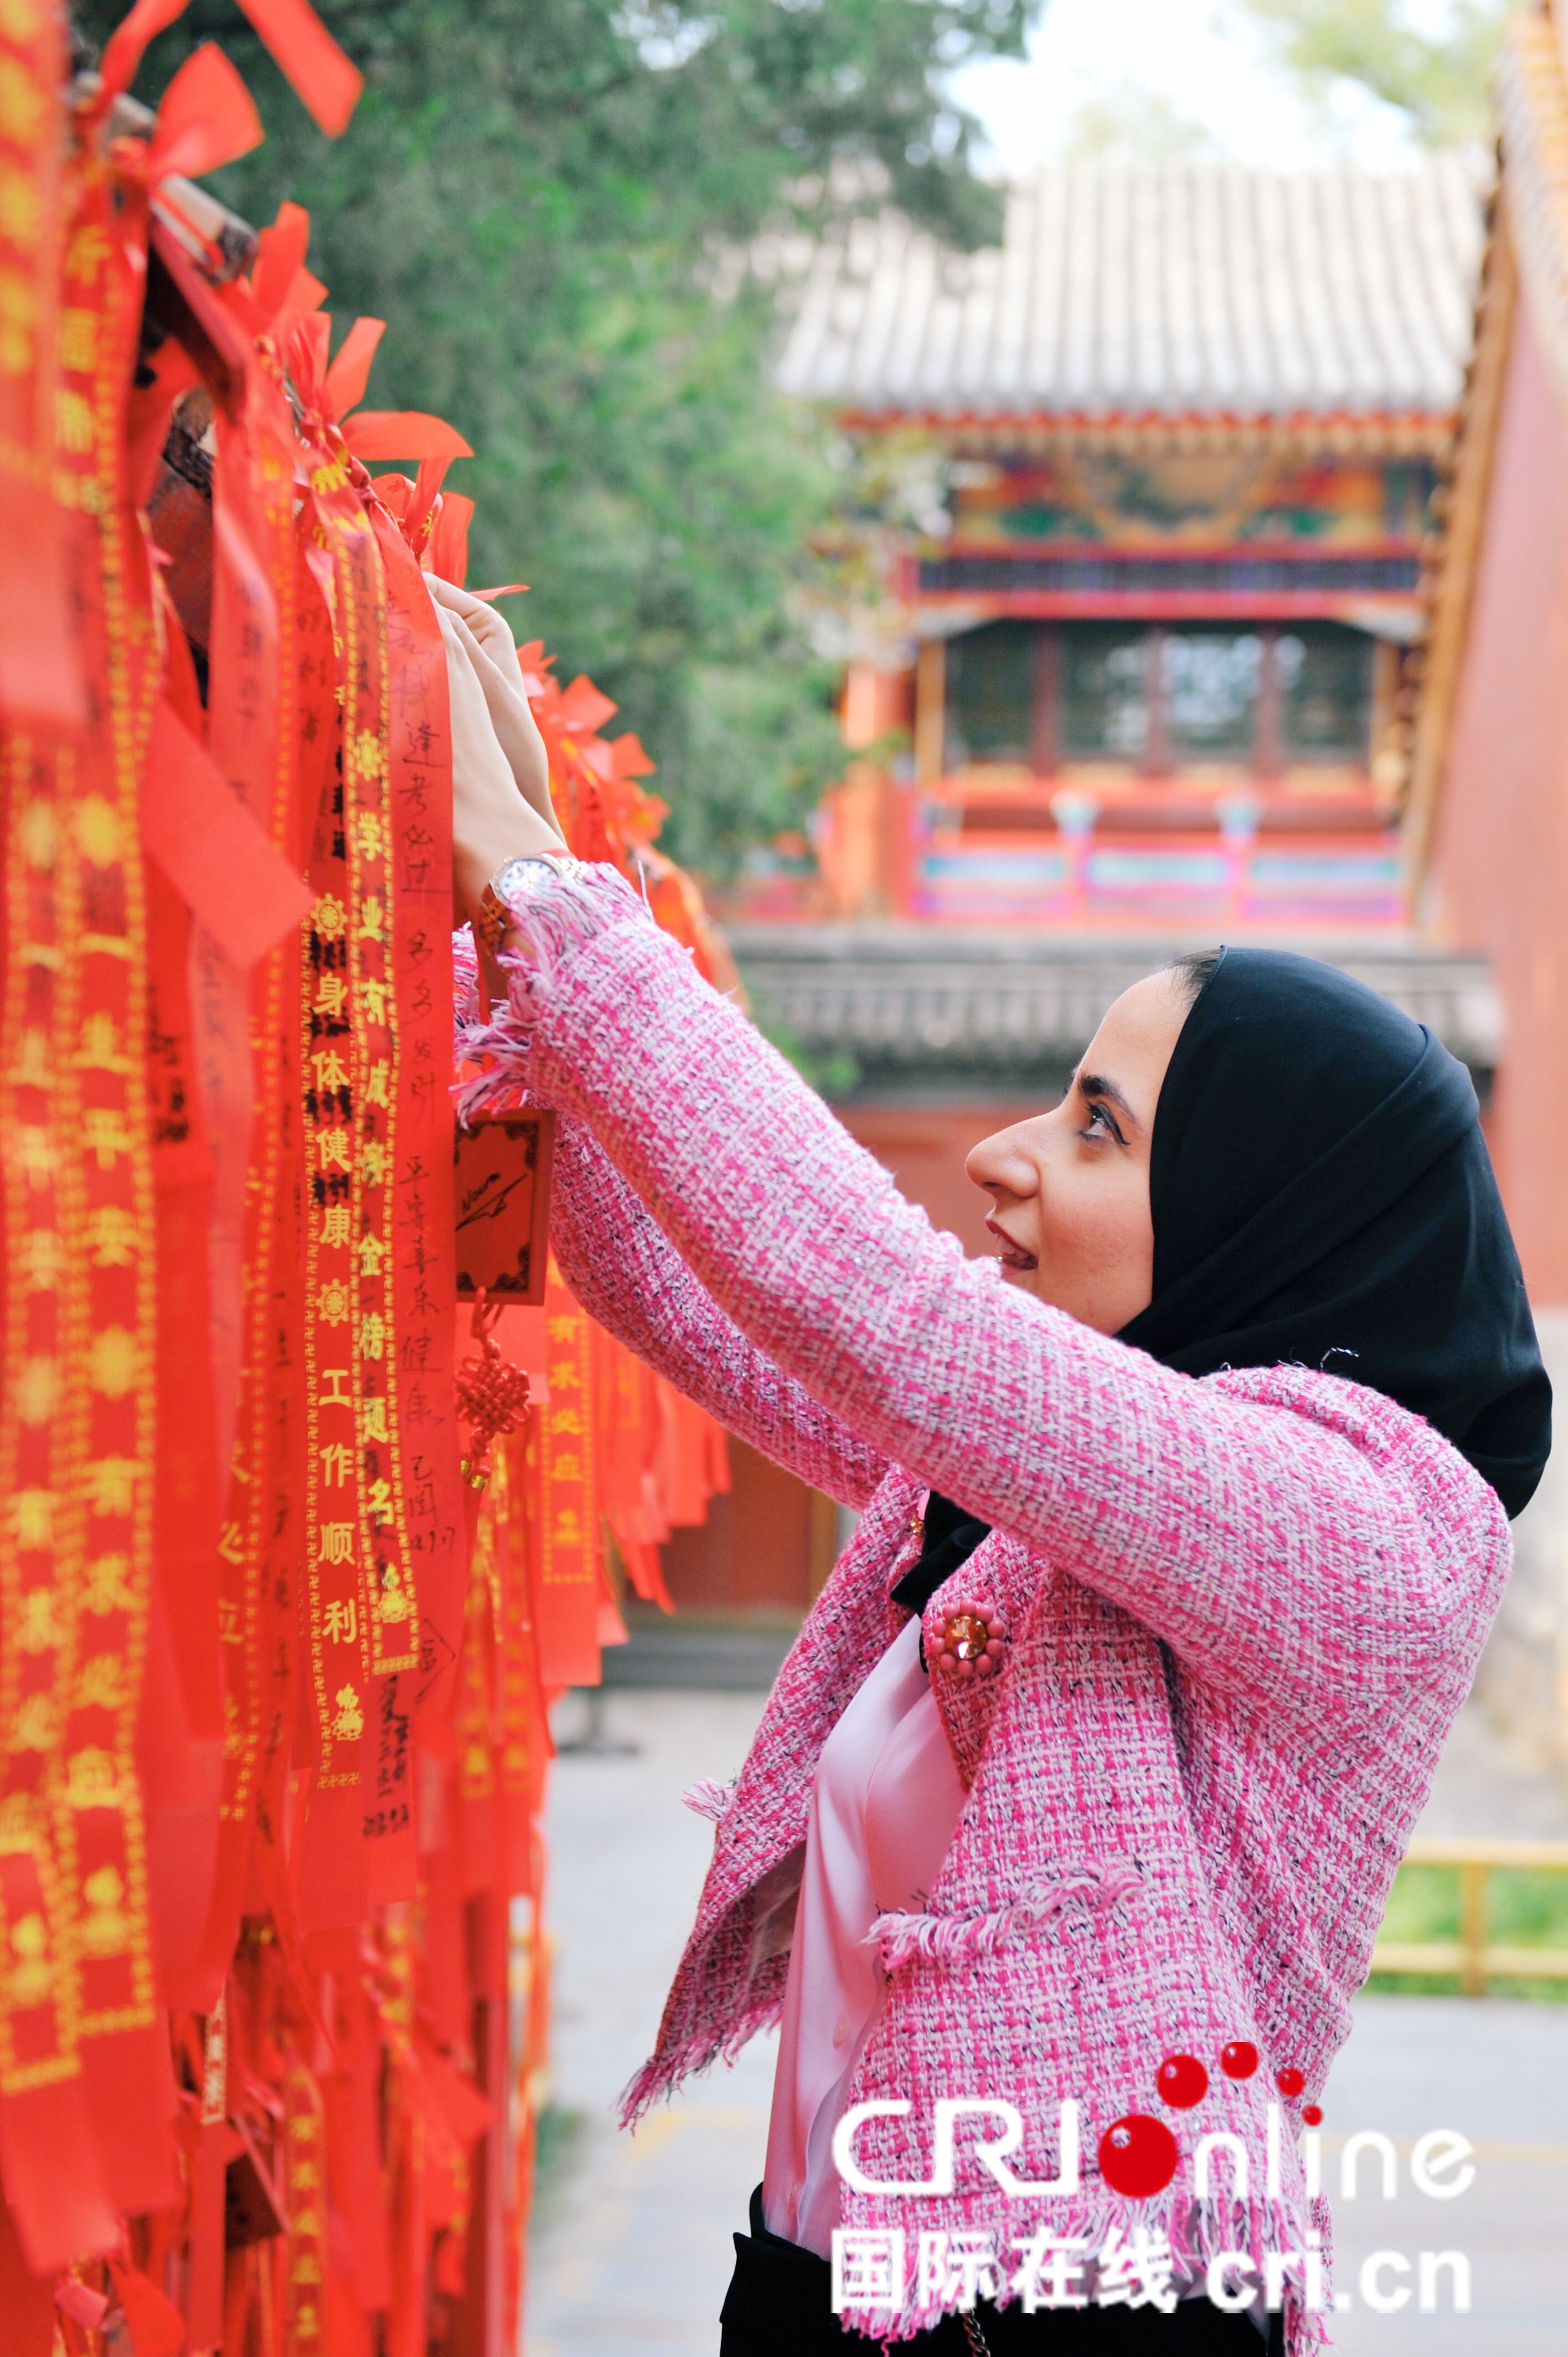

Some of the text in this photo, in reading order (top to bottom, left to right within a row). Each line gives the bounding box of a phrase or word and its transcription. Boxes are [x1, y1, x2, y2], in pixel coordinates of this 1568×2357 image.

[310, 971, 353, 1249] 身体健康
[317, 1369, 357, 1645] 工作顺利
[356, 1233, 395, 1527] 金榜题名
